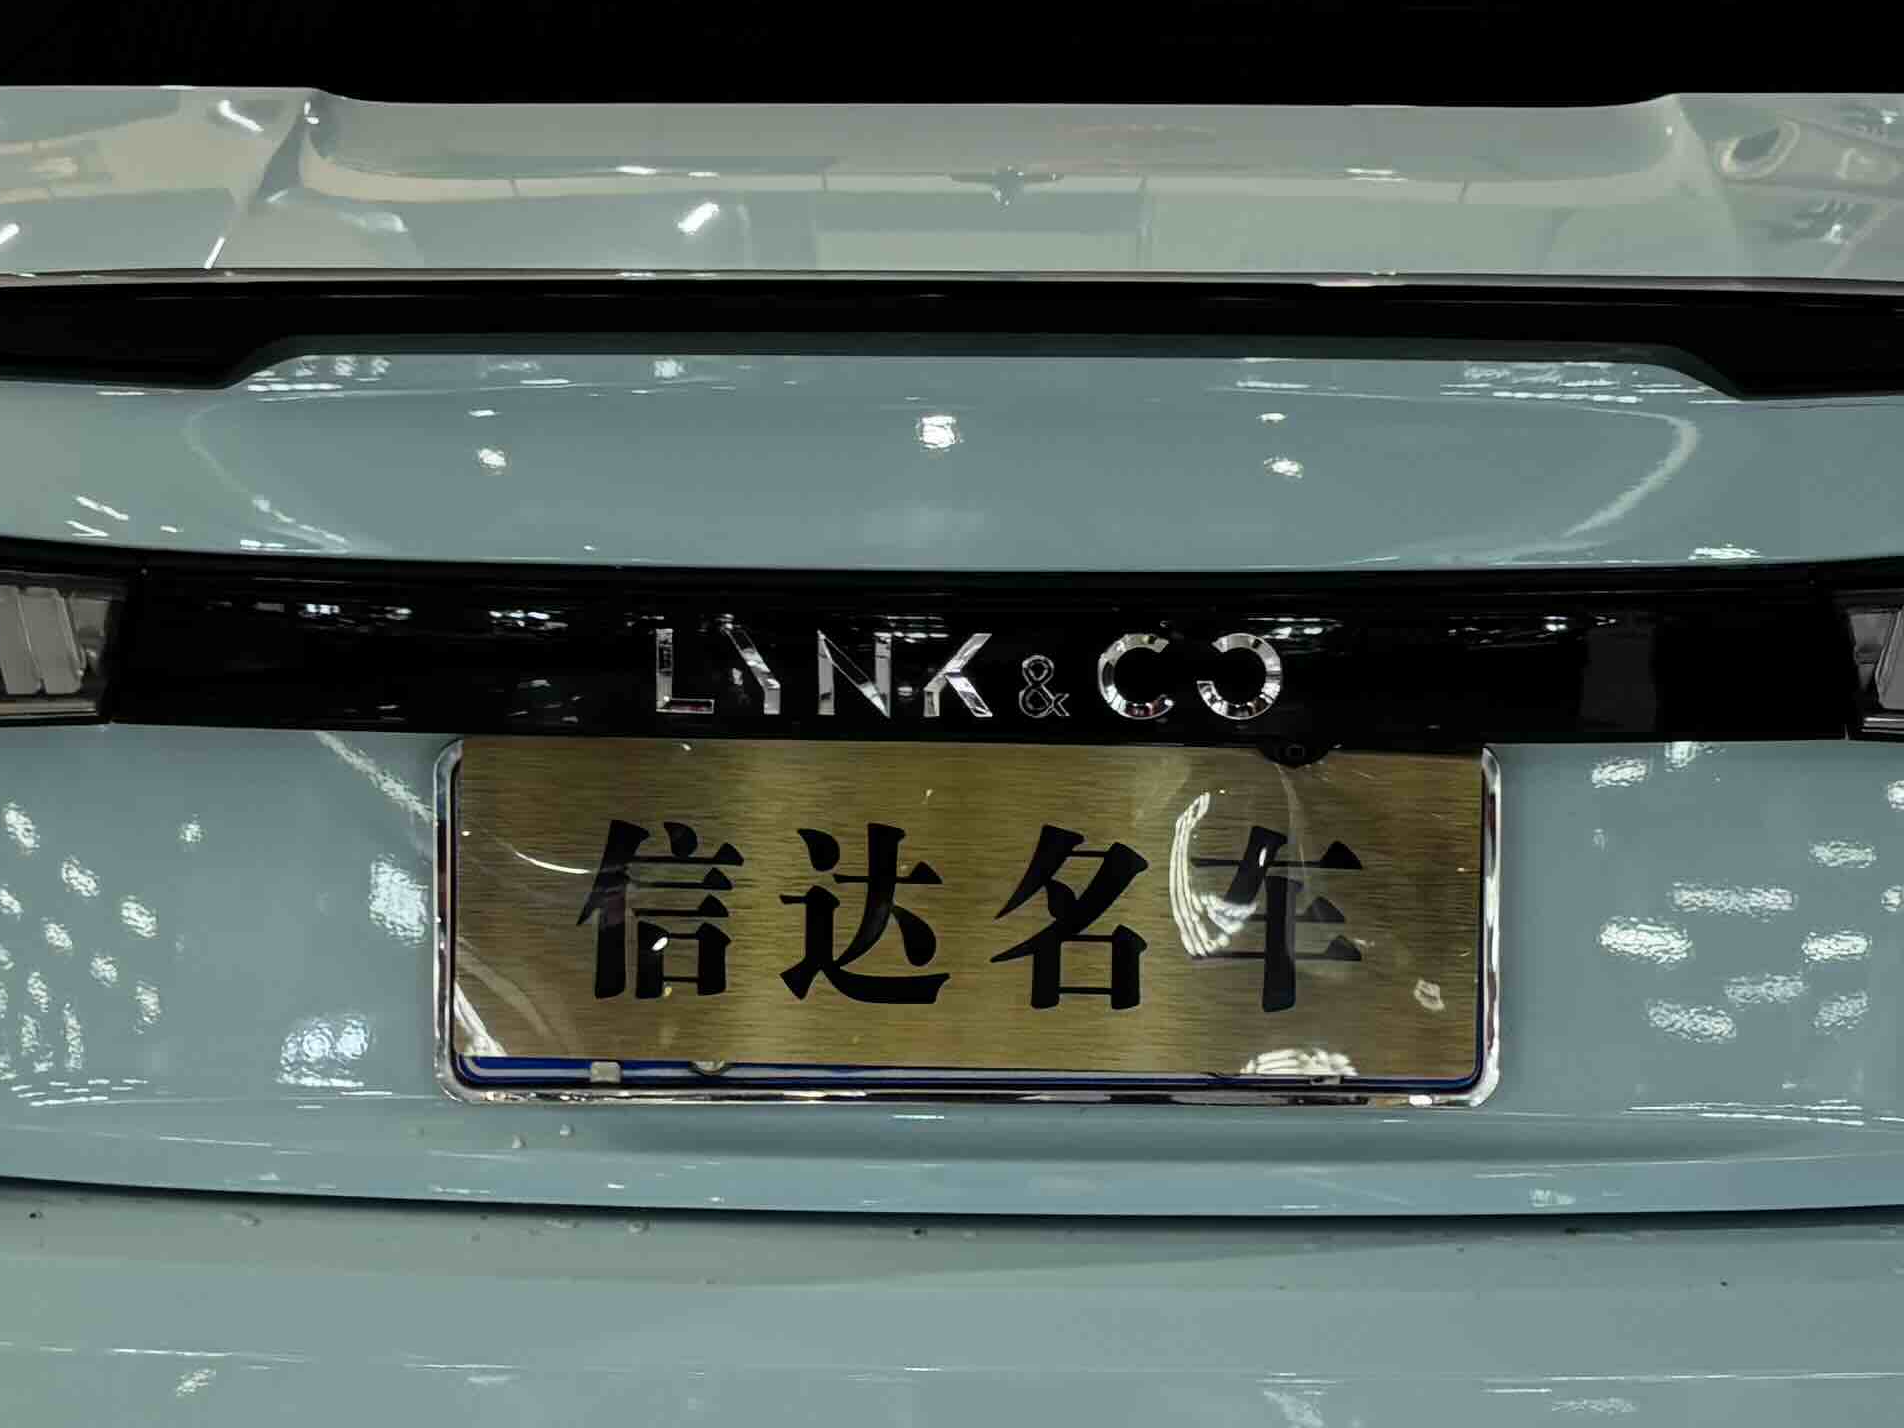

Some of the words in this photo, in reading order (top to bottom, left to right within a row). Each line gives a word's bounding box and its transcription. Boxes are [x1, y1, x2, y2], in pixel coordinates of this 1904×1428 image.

[1018, 653, 1070, 720] &
[1097, 631, 1283, 721] CO
[577, 818, 1364, 1013] 信达名车
